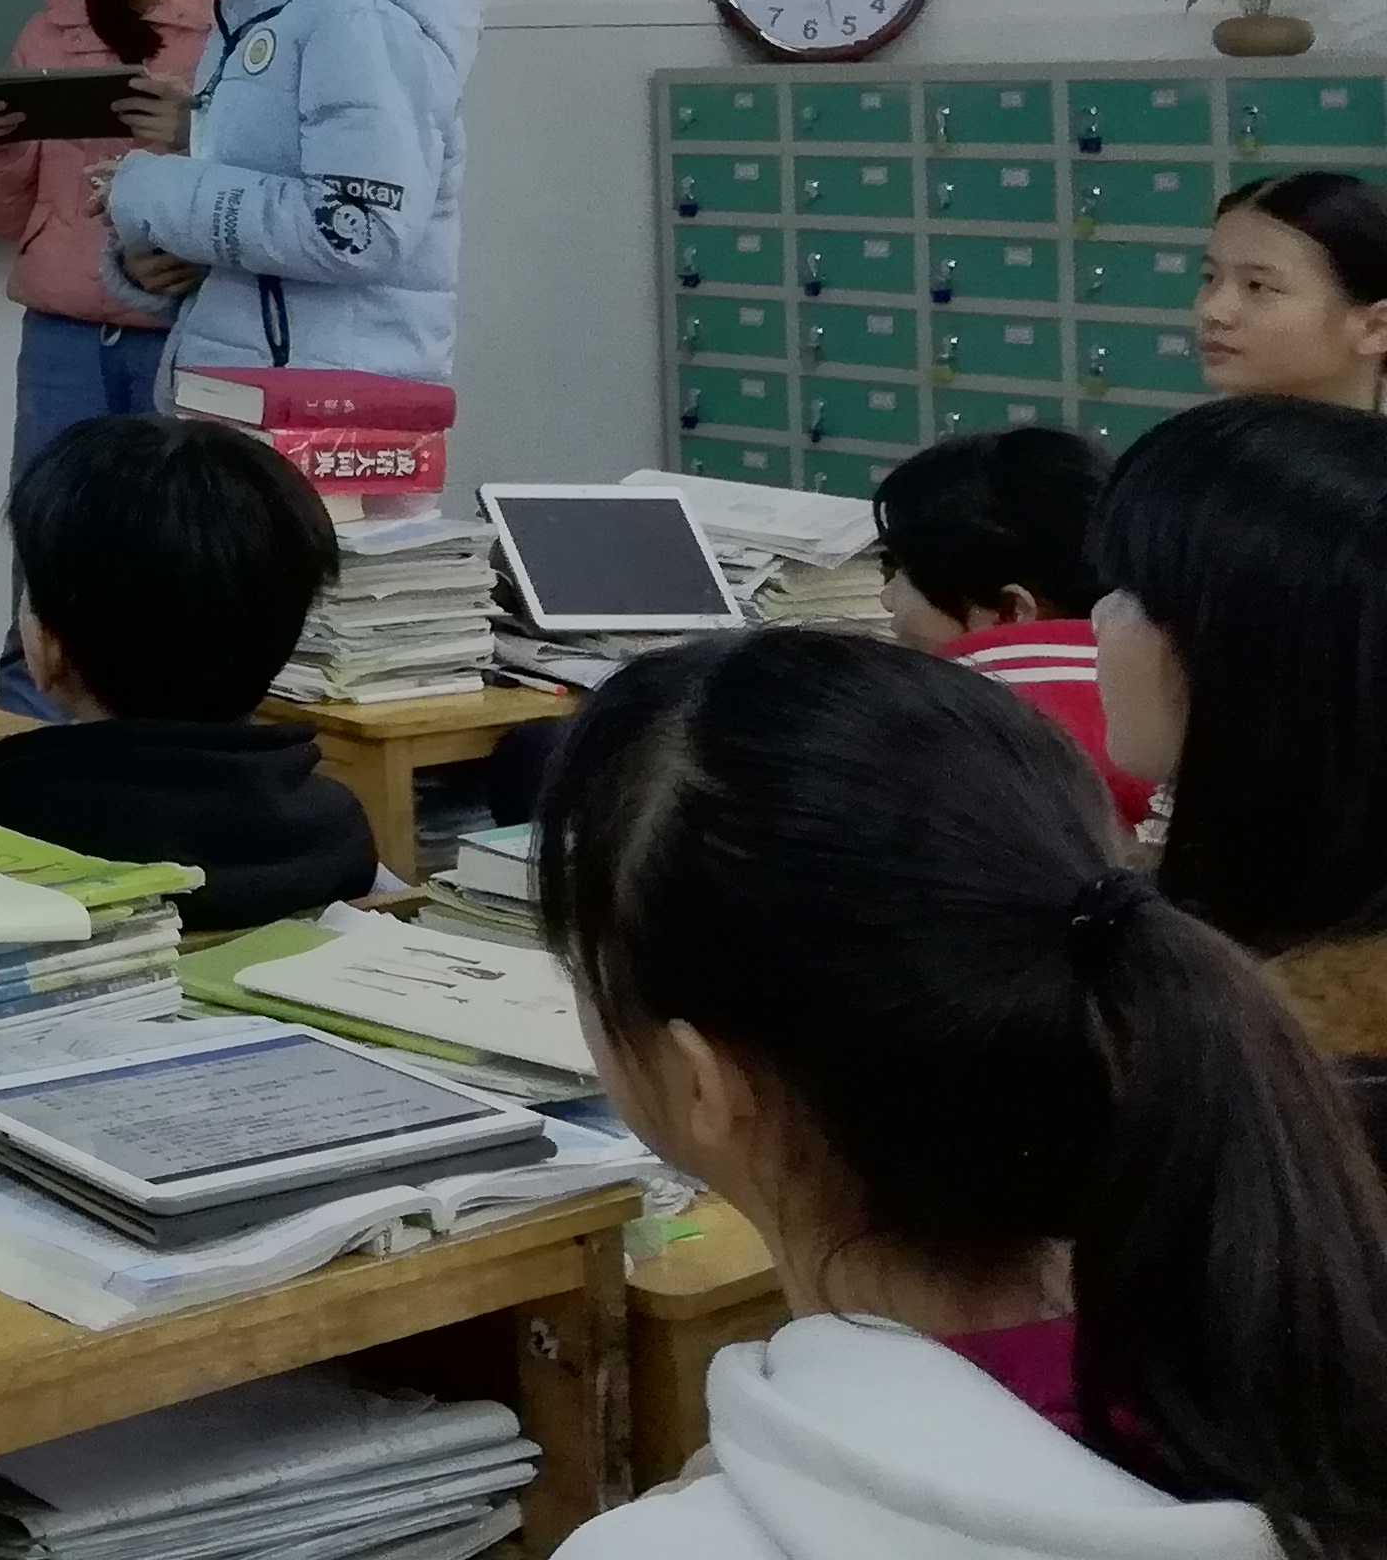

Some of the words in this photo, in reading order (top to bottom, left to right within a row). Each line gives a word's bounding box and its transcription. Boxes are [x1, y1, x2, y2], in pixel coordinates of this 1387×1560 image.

[768, 6, 783, 27] 7
[841, 15, 857, 36] 5
[802, 18, 818, 40] 6
[346, 180, 401, 209] okay
